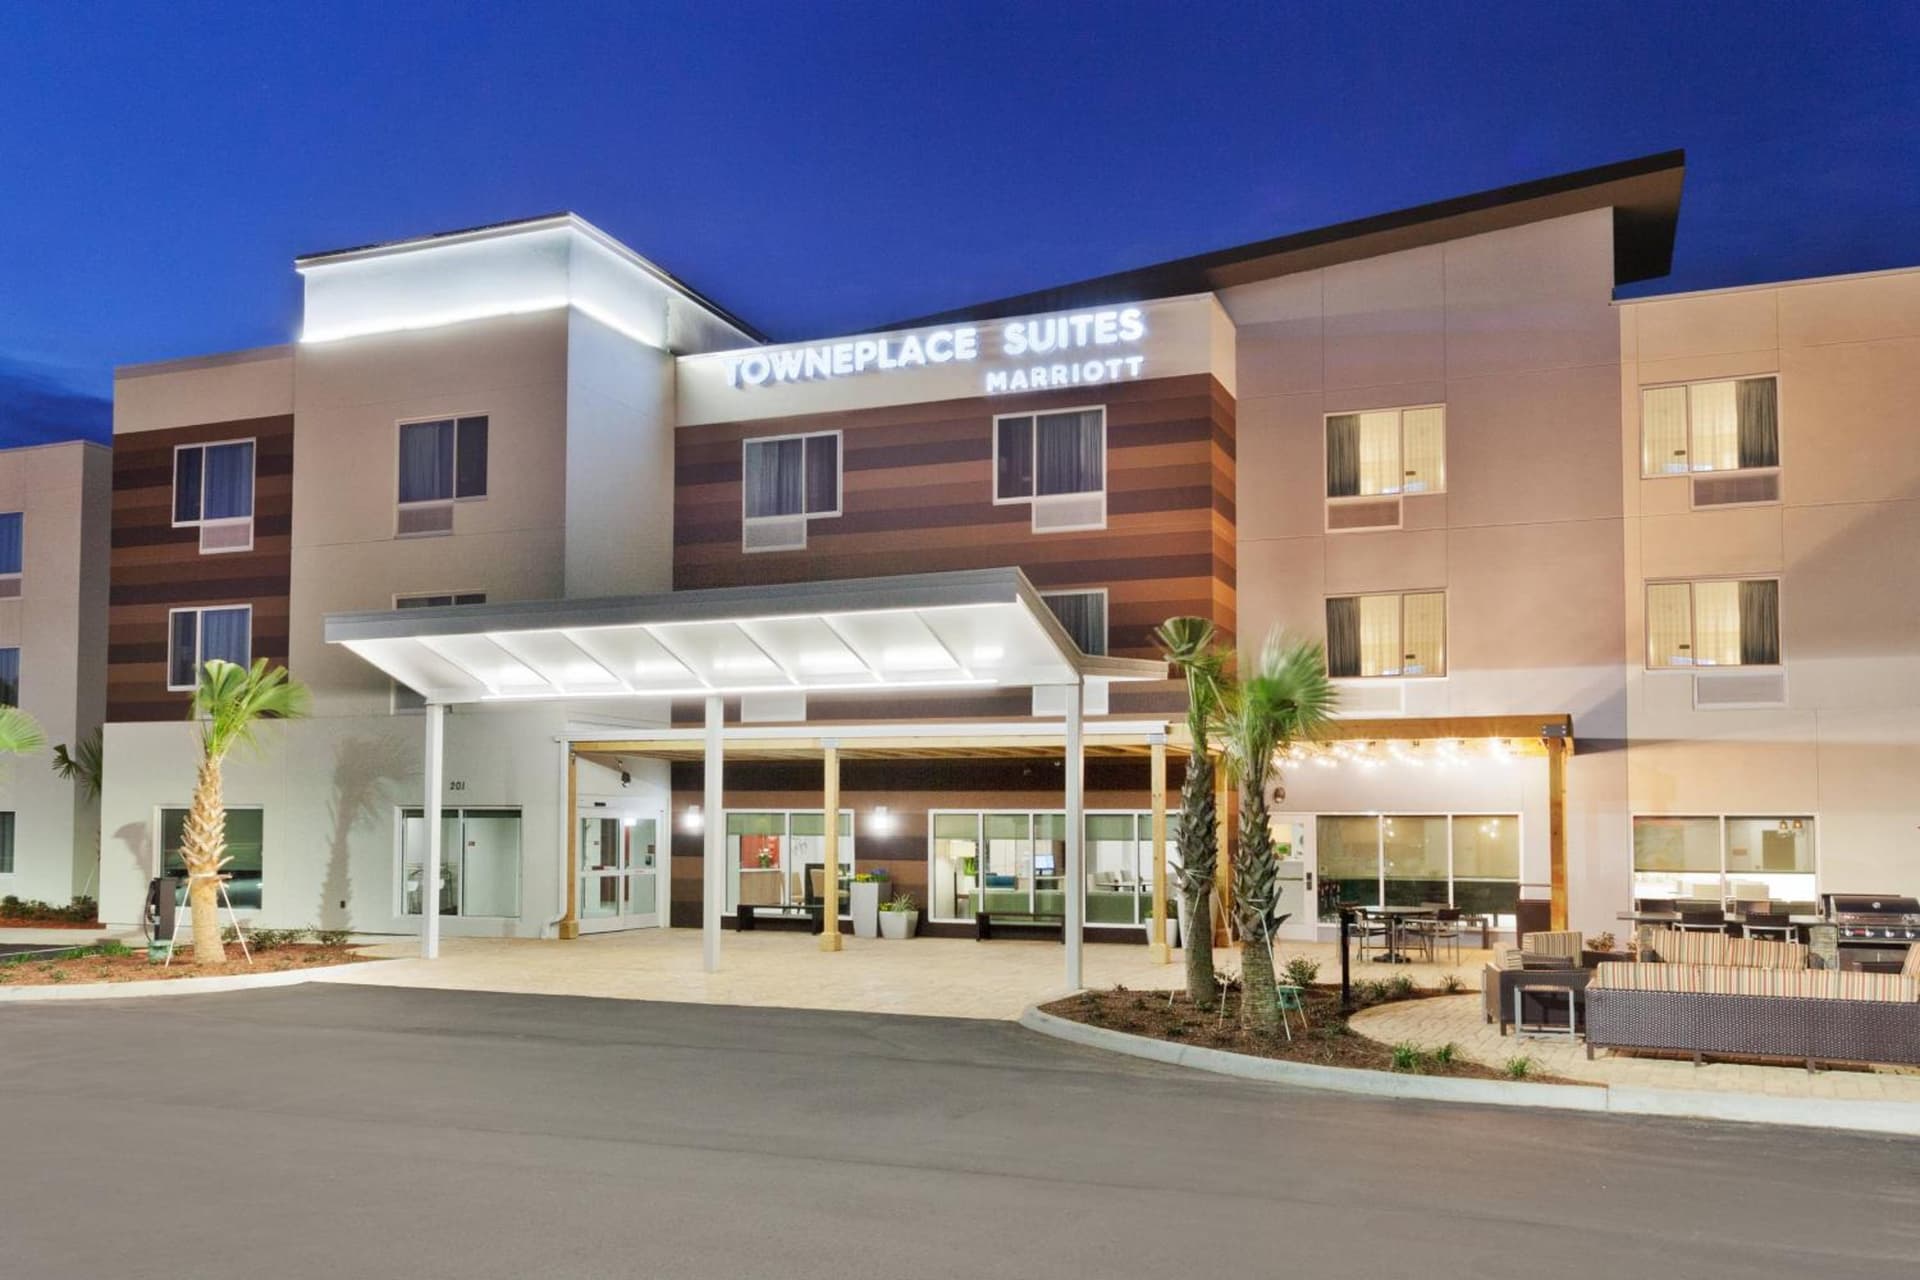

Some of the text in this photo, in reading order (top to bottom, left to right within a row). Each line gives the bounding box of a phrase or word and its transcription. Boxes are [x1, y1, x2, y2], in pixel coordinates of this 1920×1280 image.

[723, 308, 1145, 386] TOWNEPLACE SUITES
[985, 356, 1144, 393] MARRIOTT
[450, 781, 465, 790] 201
